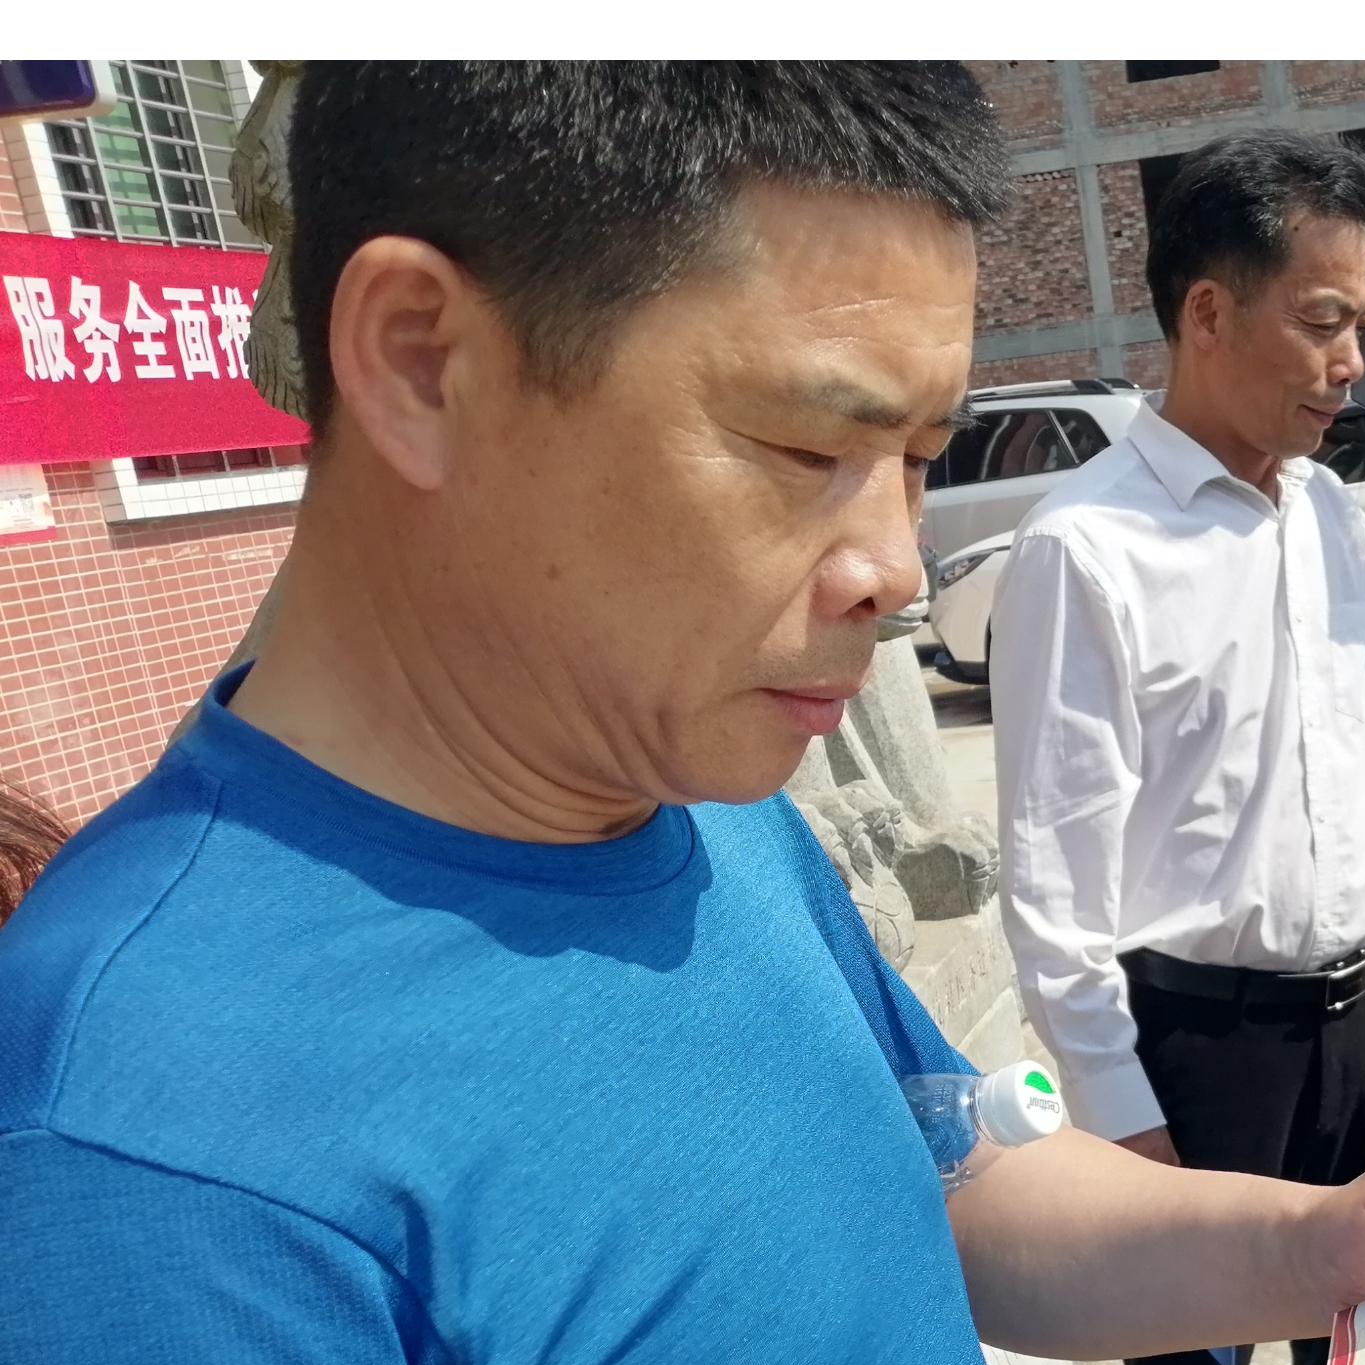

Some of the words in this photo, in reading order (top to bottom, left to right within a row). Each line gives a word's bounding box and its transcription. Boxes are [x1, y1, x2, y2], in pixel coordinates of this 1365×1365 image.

[3, 275, 258, 383] 服务全面推
